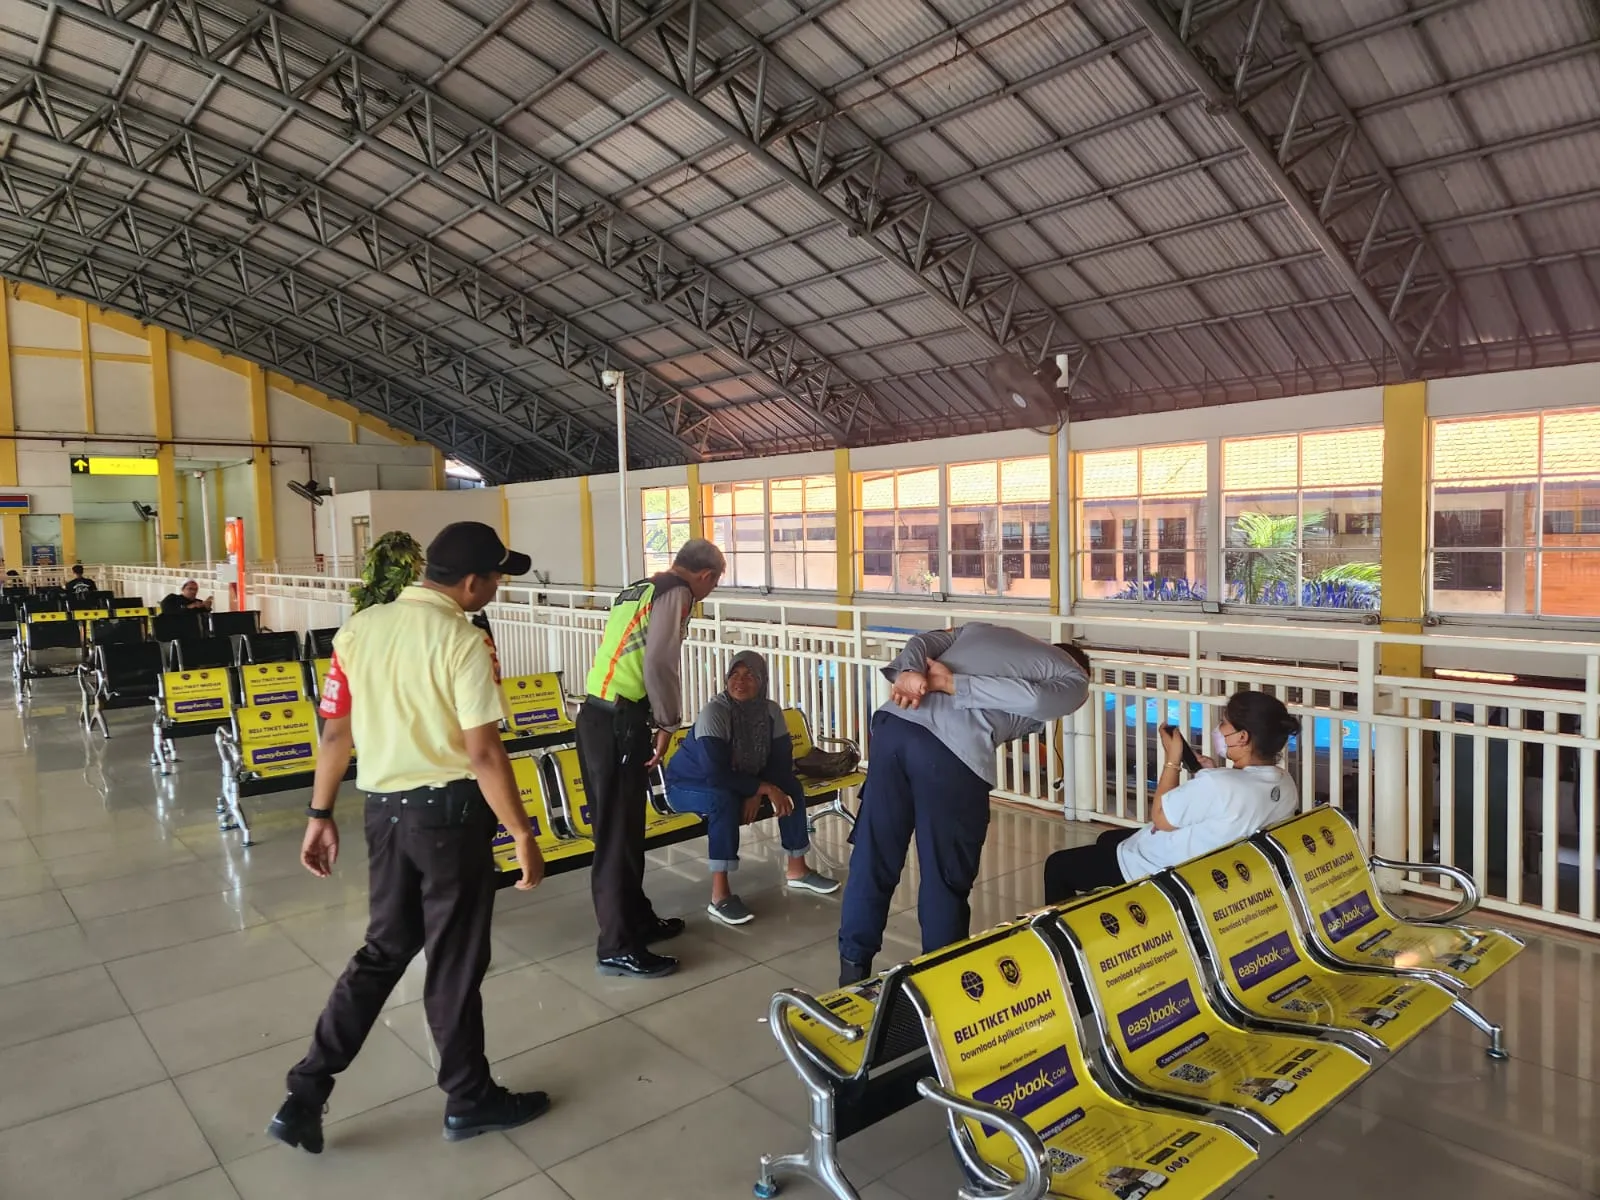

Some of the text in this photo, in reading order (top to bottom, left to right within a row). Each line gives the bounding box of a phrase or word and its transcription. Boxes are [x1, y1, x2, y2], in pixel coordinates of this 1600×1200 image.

[1317, 861, 1334, 877] TIKET
[1213, 887, 1274, 922] BELI TIKET MUDAH
[1099, 930, 1174, 973] BELI TIKET MUDAH
[1105, 968, 1134, 988] Download
[954, 988, 1052, 1045] BELI TIKET MUDAH
[960, 1008, 1057, 1062] Download Aplikasi Easybook
